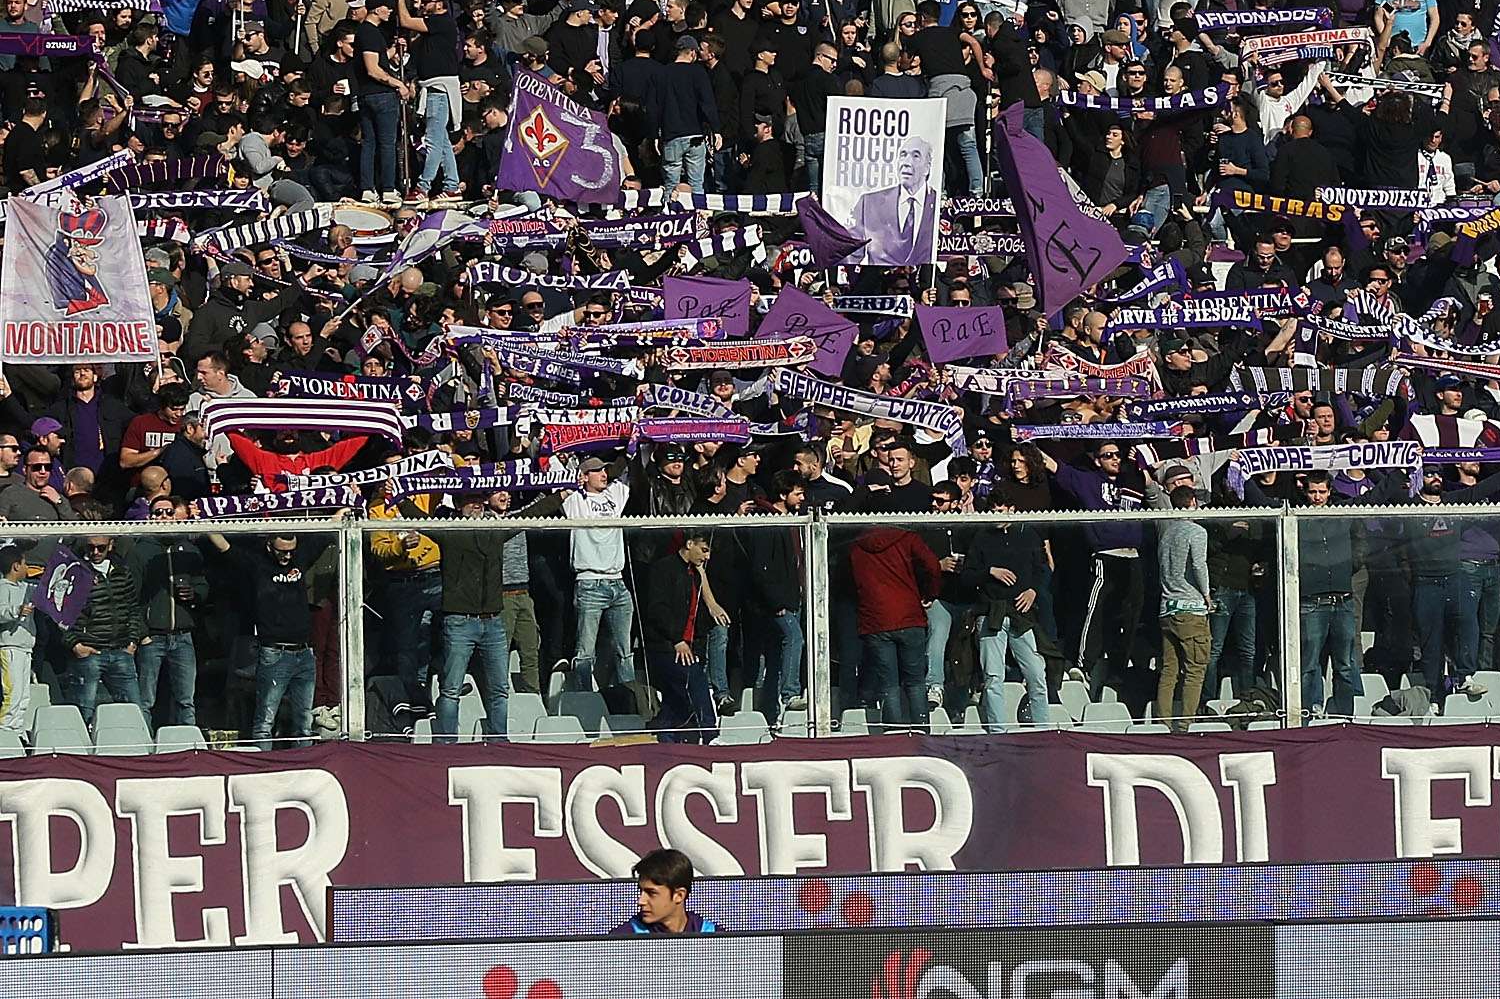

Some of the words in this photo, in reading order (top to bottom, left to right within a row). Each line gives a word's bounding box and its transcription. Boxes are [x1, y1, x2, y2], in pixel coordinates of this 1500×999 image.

[1196, 8, 1318, 29] AFICIONADOS
[45, 40, 78, 51] Firenze
[517, 71, 593, 121] IORENTINA
[837, 107, 910, 137] ROCCO
[1233, 189, 1346, 222] ULTRAS
[1183, 306, 1253, 324] FIESOLE
[4, 320, 153, 358] MONTAIONE
[691, 346, 789, 362] FIORENTINA
[291, 376, 403, 402] FIORENTINA
[778, 370, 855, 409] SIEMPRE
[1168, 395, 1238, 410] FIORENTINA
[1349, 440, 1421, 467] CONTIG
[305, 449, 447, 491] FIORENTINA
[265, 486, 358, 510] STRAN
[3, 772, 350, 951] PER
[448, 757, 972, 883] ESSER
[1086, 751, 1275, 868] DI
